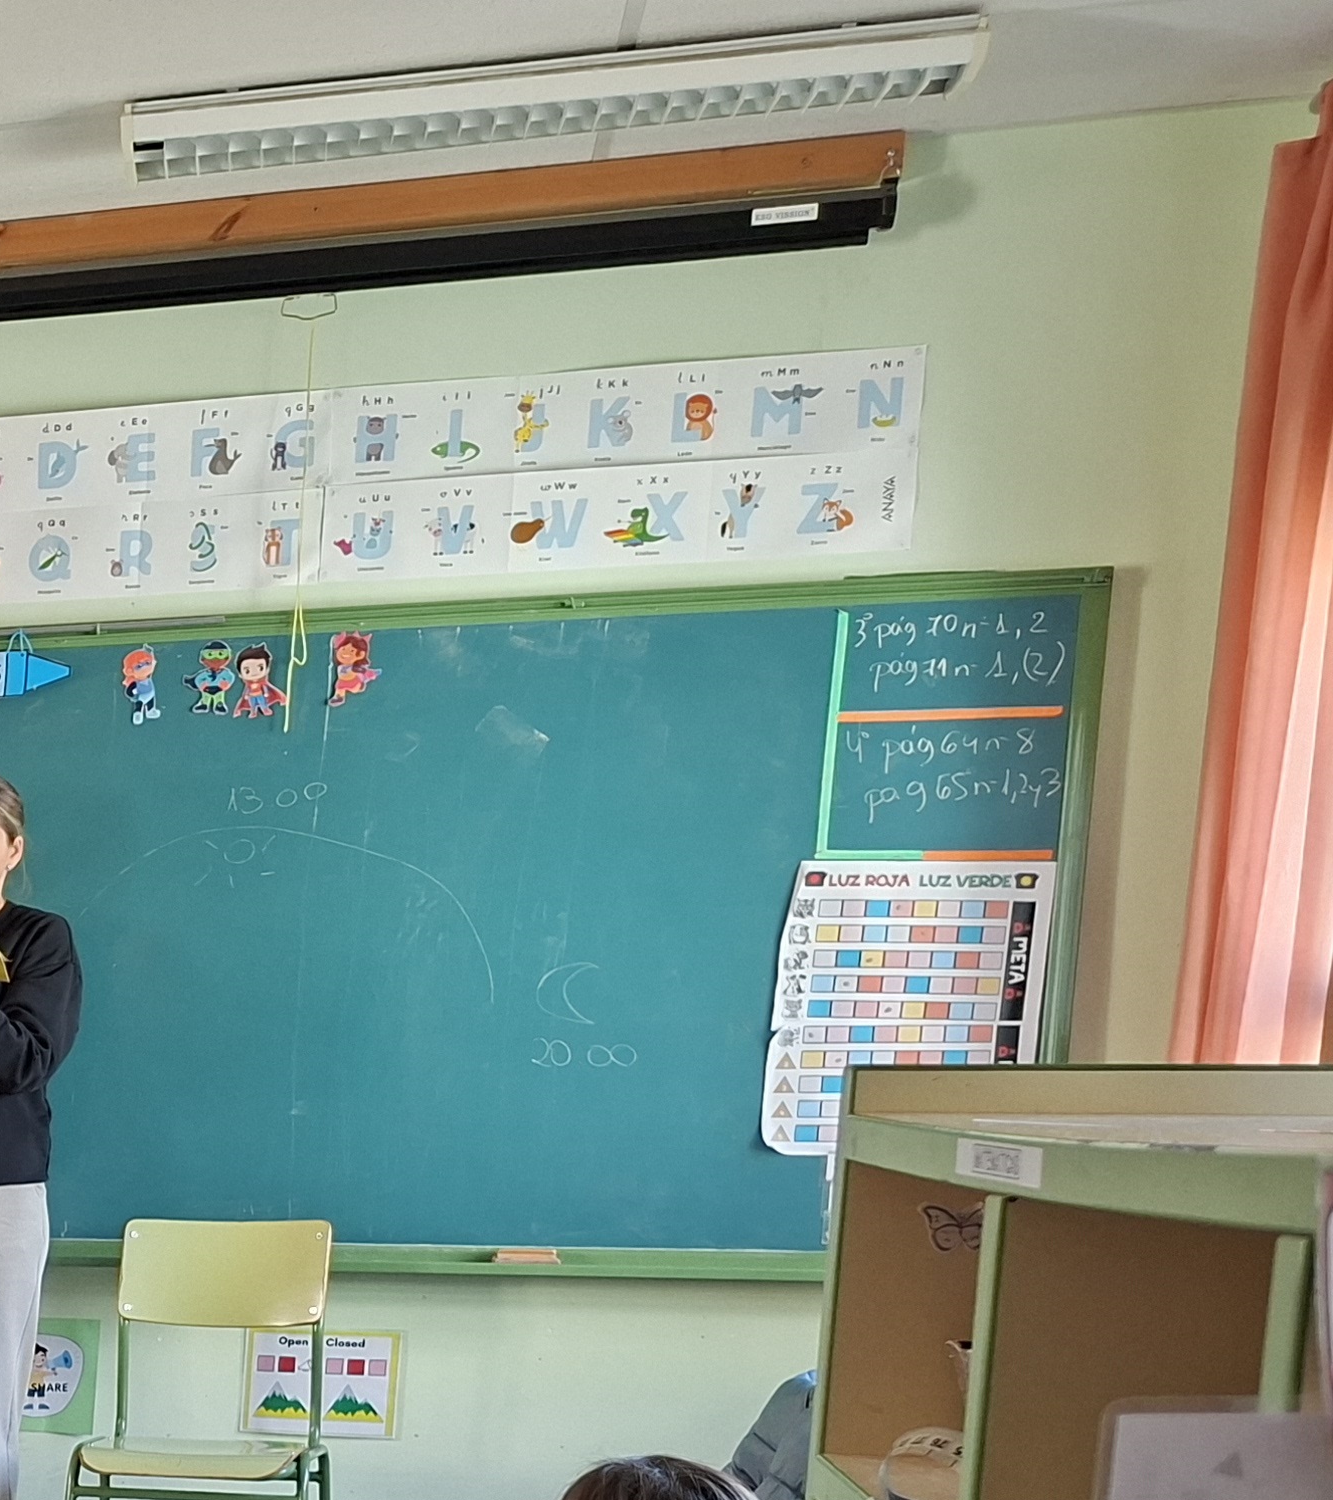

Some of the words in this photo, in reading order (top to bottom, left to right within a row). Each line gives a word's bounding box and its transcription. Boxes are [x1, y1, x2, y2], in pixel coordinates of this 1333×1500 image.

[881, 475, 896, 523] ANAYA
[873, 616, 917, 649] pág
[869, 652, 919, 692] pág
[882, 725, 935, 774] pág
[1017, 728, 1035, 755] 8
[227, 786, 264, 814] 13
[828, 874, 860, 887] LUZ
[865, 874, 910, 888] ROJA
[919, 874, 952, 888] LUZ
[956, 874, 1013, 888] VERDE
[1006, 935, 1030, 985] META
[531, 1038, 572, 1067] 20
[586, 1044, 638, 1067] 00
[278, 1336, 309, 1348] Open
[325, 1336, 366, 1349] Closed
[30, 1382, 69, 1393] SHARE
